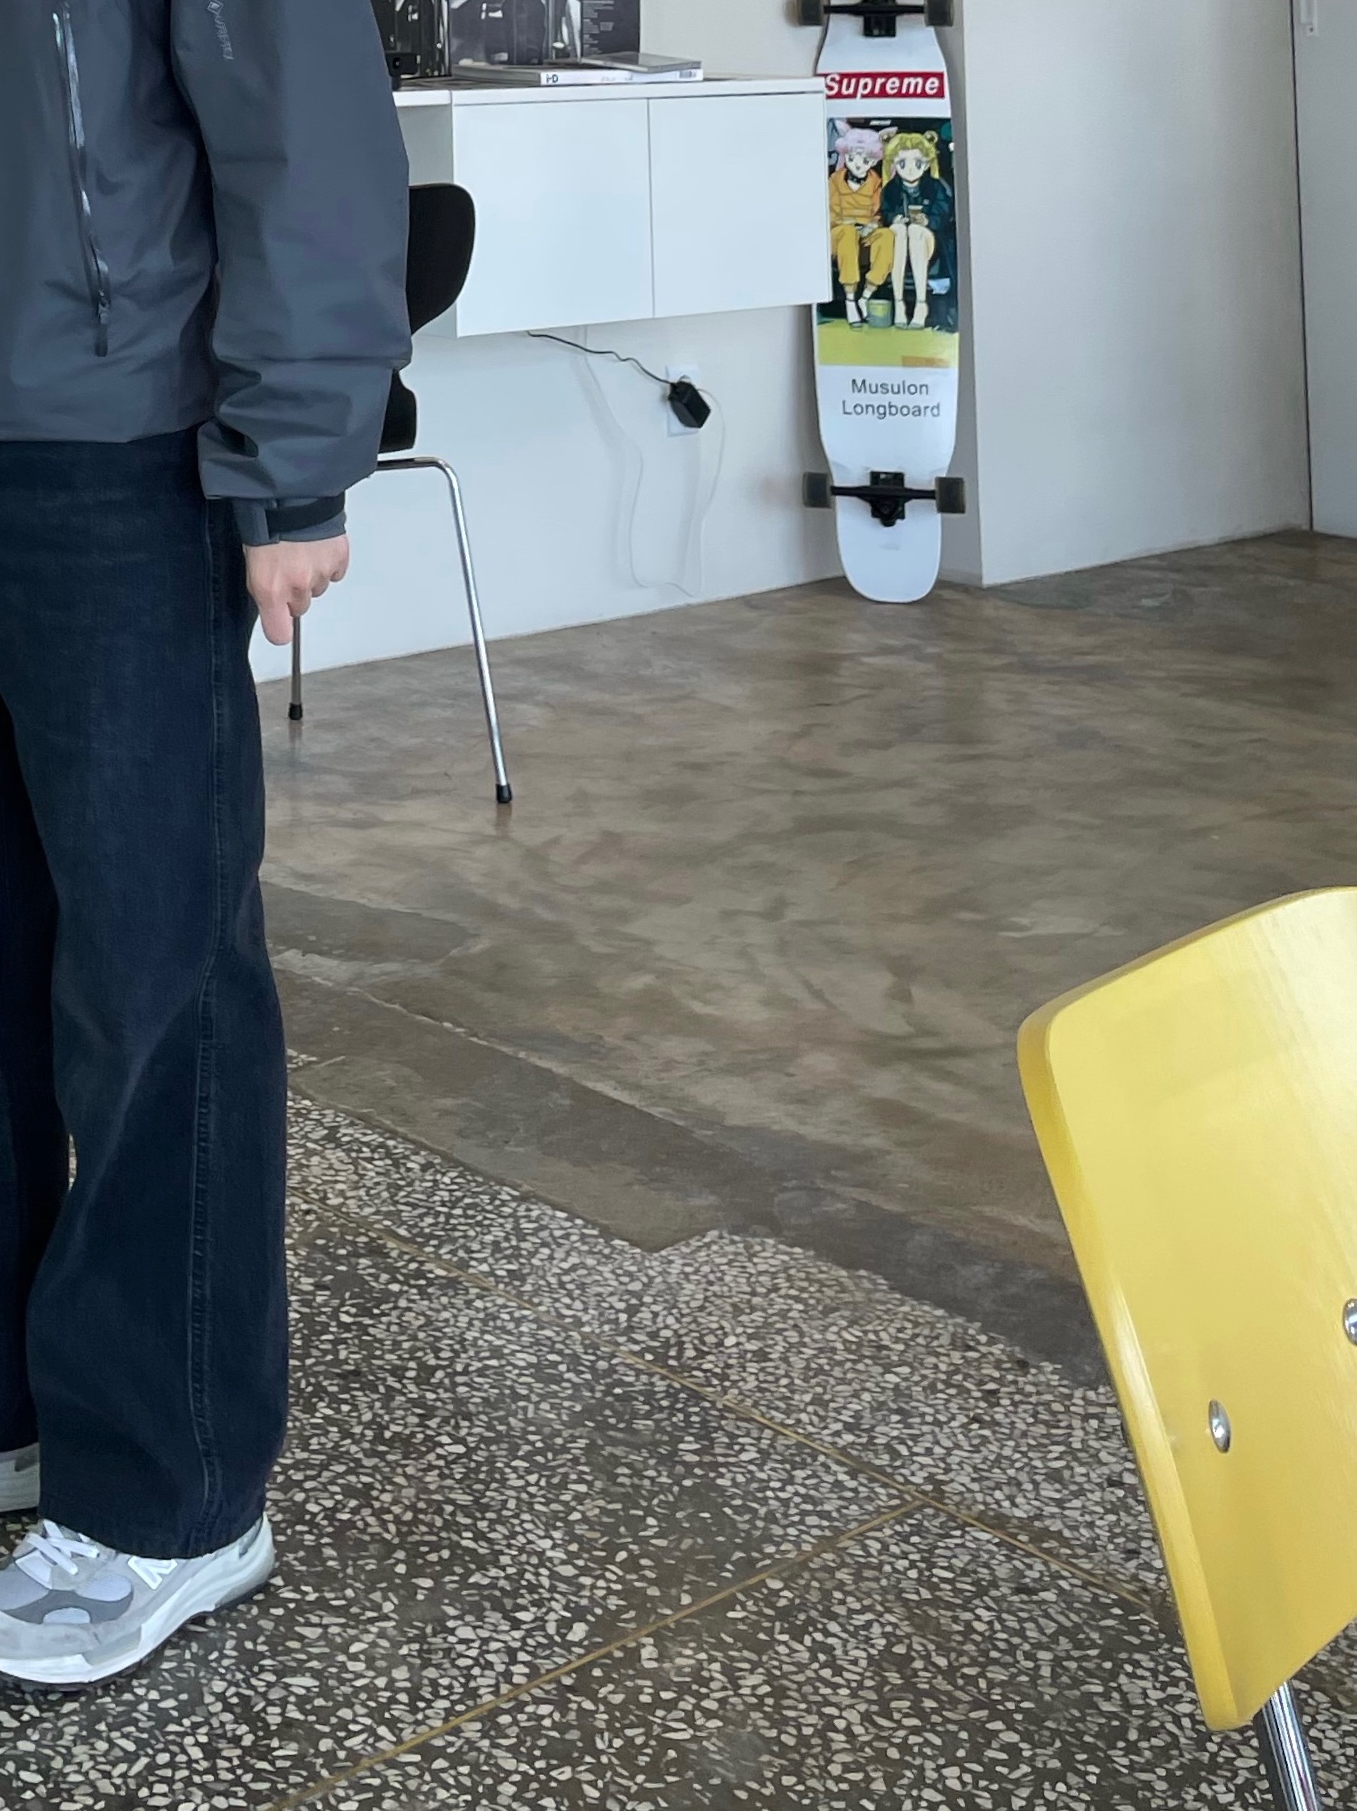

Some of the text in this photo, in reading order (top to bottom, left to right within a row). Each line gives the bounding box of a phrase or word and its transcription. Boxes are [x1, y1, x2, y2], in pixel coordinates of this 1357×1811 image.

[825, 73, 940, 99] Supreme
[850, 378, 929, 396] Musulon
[841, 399, 941, 421] Longboard
